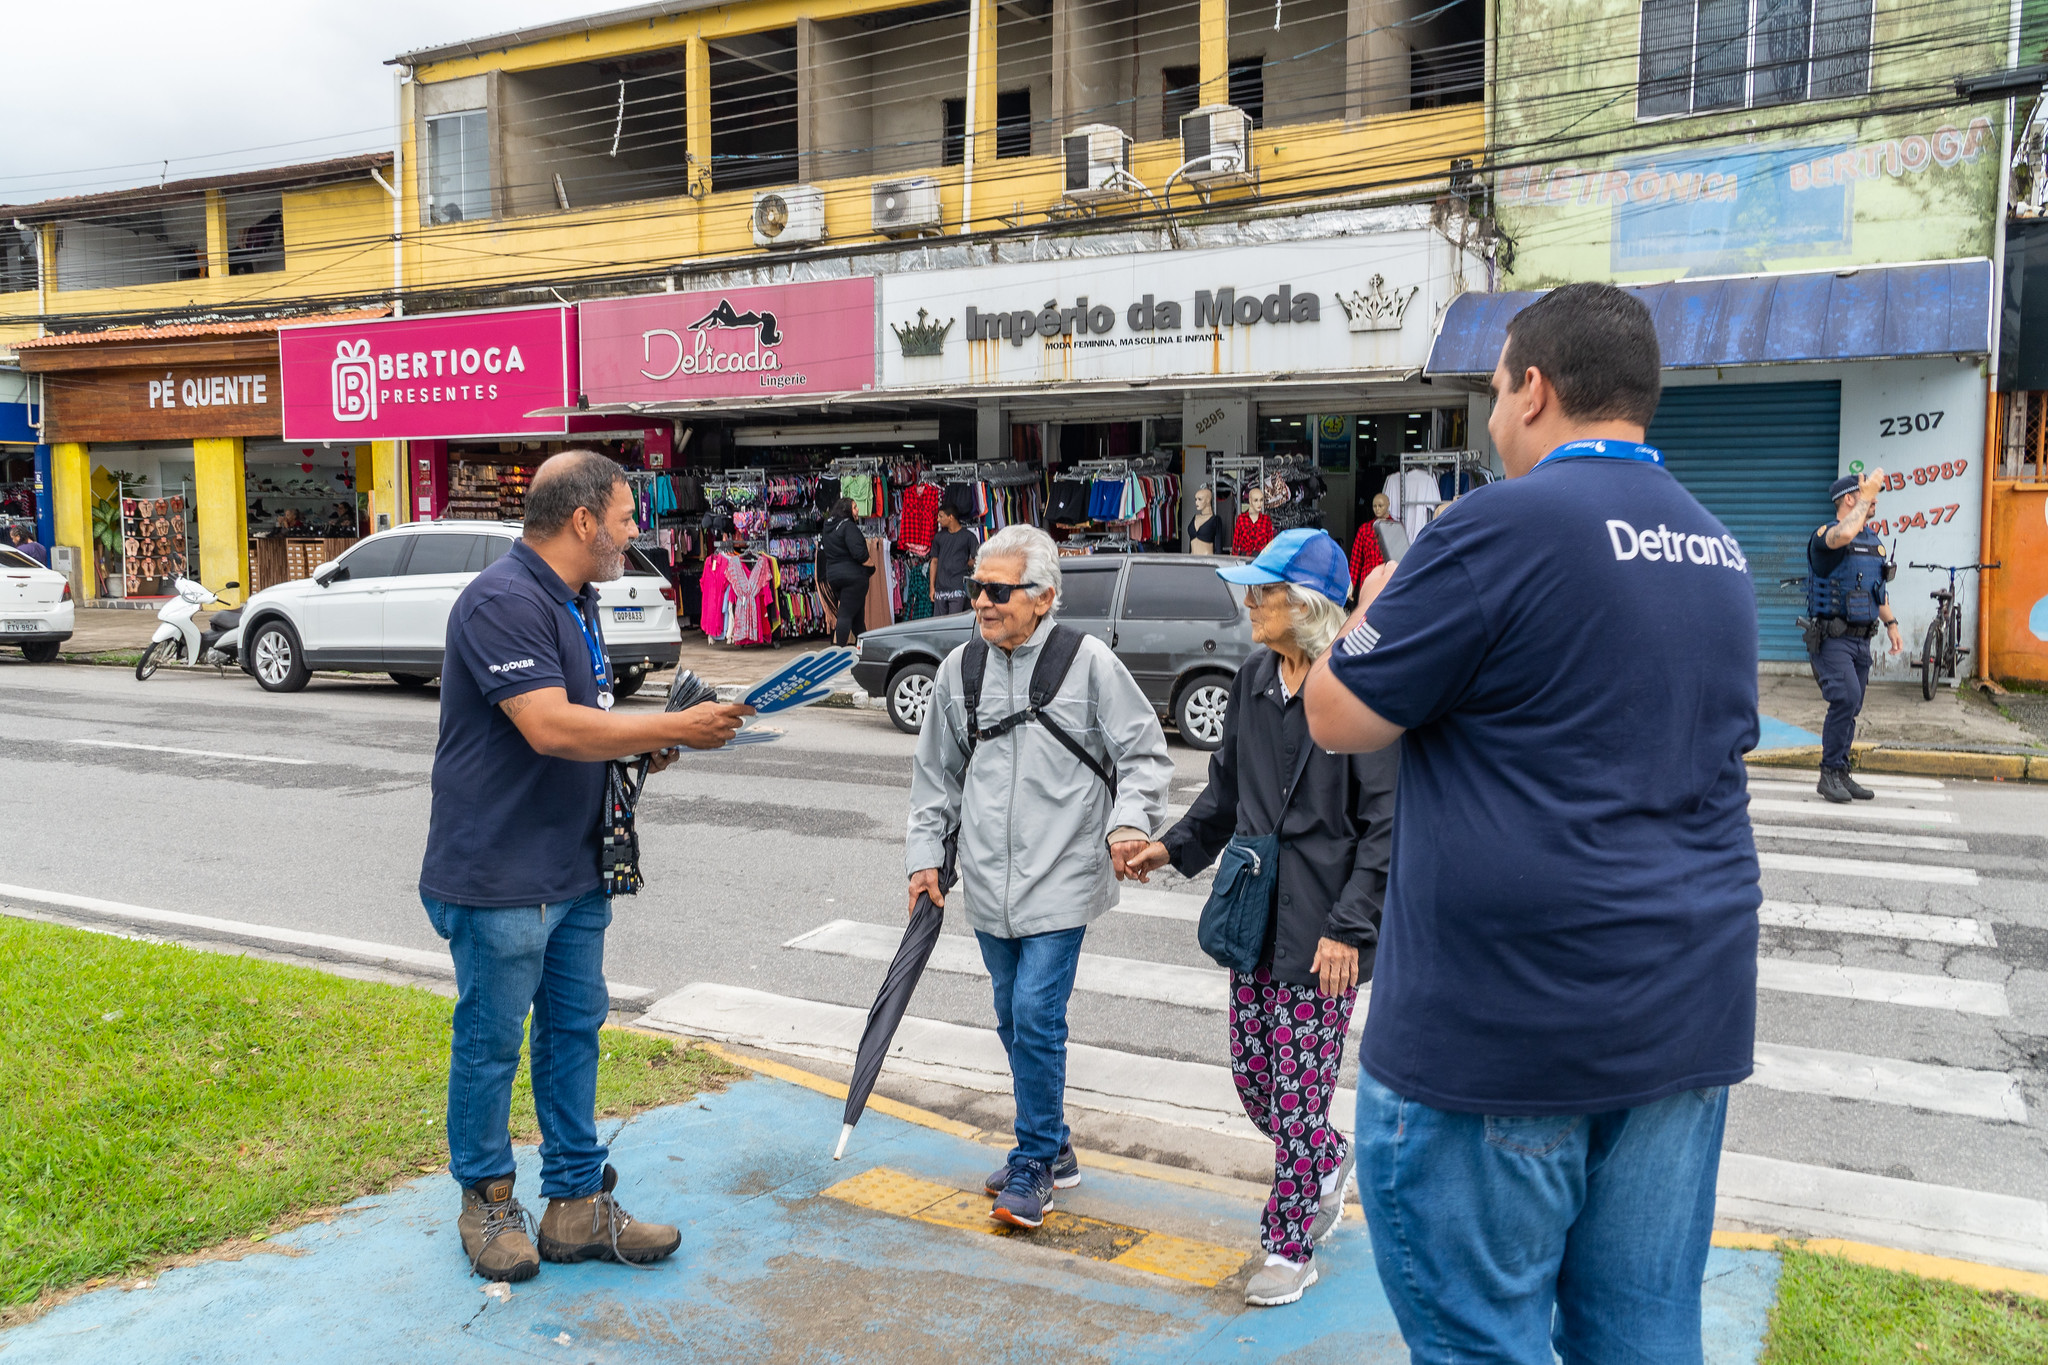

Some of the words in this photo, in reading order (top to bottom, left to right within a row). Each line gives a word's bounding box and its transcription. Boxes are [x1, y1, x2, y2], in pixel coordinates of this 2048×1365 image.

[1789, 116, 1998, 191] BERTIOGA
[966, 298, 1116, 346] Império
[1127, 294, 1182, 331] da
[1194, 284, 1321, 328] Moda
[640, 326, 782, 380] Delicada
[1045, 341, 1071, 350] MODA
[1073, 339, 1118, 349] FEMININA,
[1119, 337, 1174, 347] MASCULINA
[1184, 333, 1225, 343] INFANTIL
[378, 345, 526, 381] BERTIOGA
[149, 372, 176, 409] PÉ
[182, 374, 267, 408] QUENTE
[381, 384, 498, 404] PRESENTES
[760, 373, 807, 389] Lingerie
[1195, 408, 1225, 435] 2295
[1880, 411, 1944, 437] 2307
